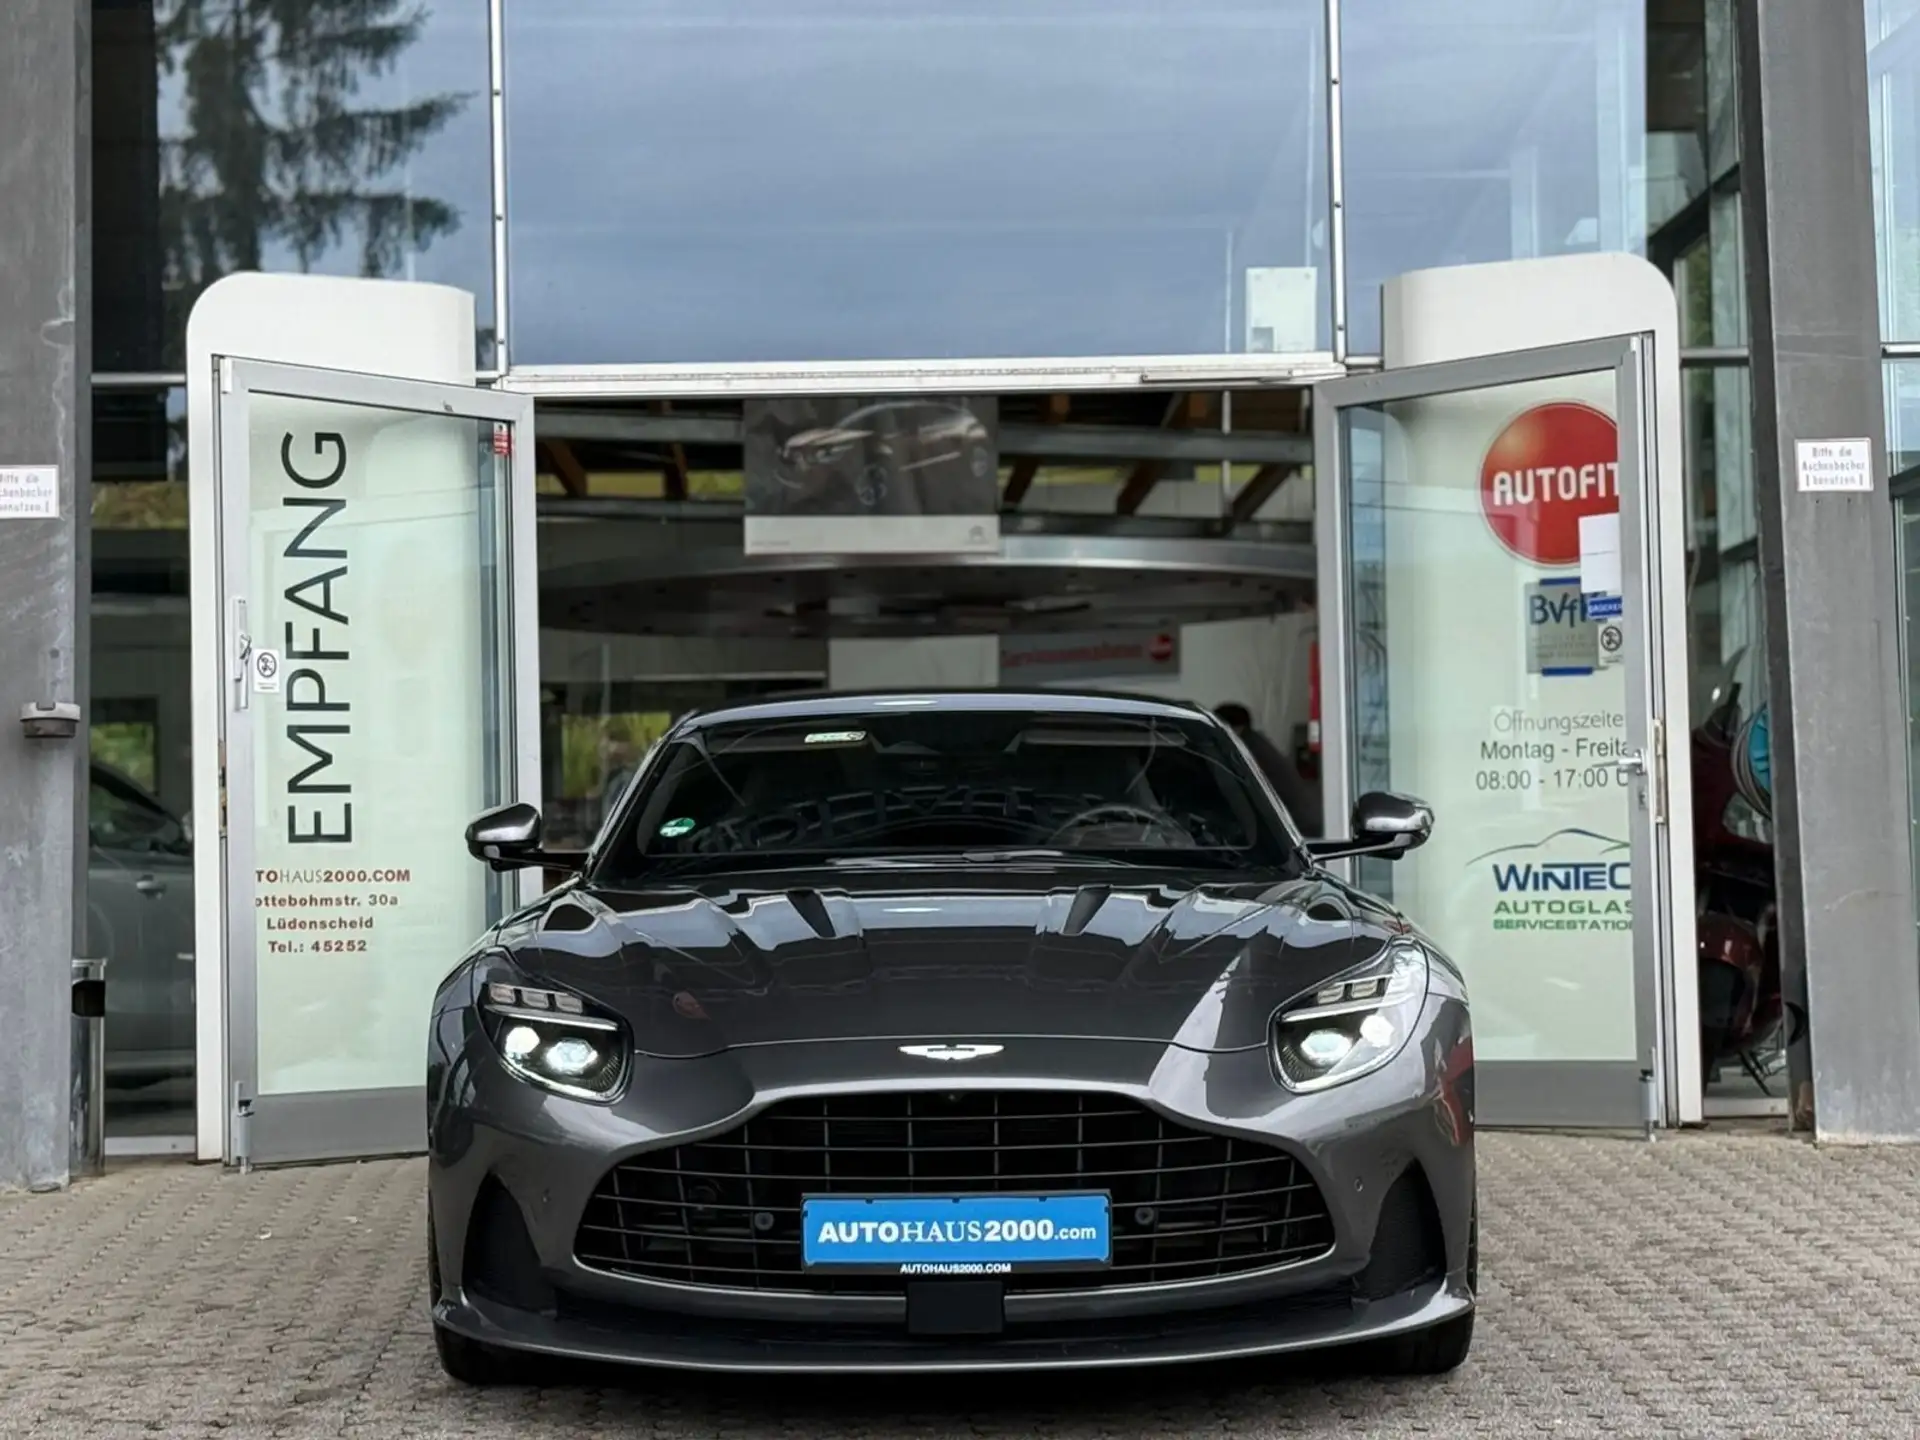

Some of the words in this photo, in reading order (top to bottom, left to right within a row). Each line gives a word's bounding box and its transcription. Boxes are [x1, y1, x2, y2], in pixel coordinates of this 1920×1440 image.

[281, 431, 352, 844] EMPFANG
[1494, 709, 1624, 736] Öffnungszeite
[1481, 740, 1555, 763] Montag
[1476, 770, 1531, 790] 08:00
[1554, 767, 1608, 788] 17:00
[368, 893, 398, 906] 30a
[267, 916, 374, 930] Lüdenscheid
[268, 940, 304, 953] Tel.:
[310, 939, 367, 952] 45252
[818, 1219, 1097, 1243] AUTOHAUS2000.com
[900, 1262, 1012, 1274] AUTOHAUS2000.COM
